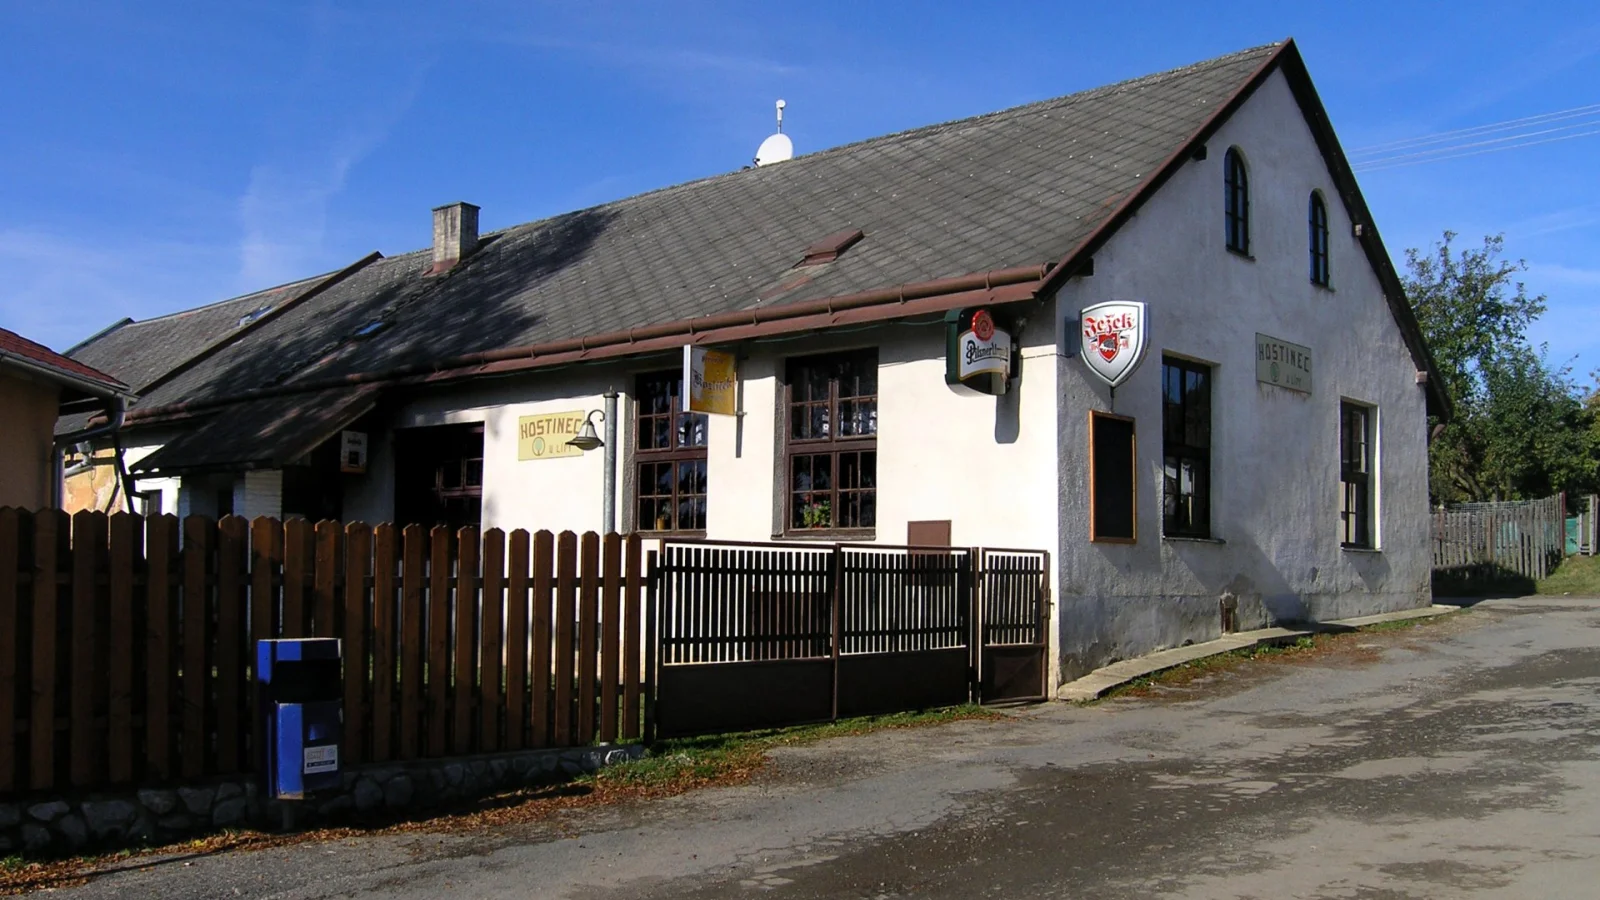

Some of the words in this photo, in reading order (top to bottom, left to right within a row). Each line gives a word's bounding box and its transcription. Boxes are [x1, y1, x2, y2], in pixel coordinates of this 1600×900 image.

[1084, 313, 1134, 338] Ježek
[1258, 343, 1310, 373] HOSTINEC
[520, 417, 582, 440] HOSTINEC
